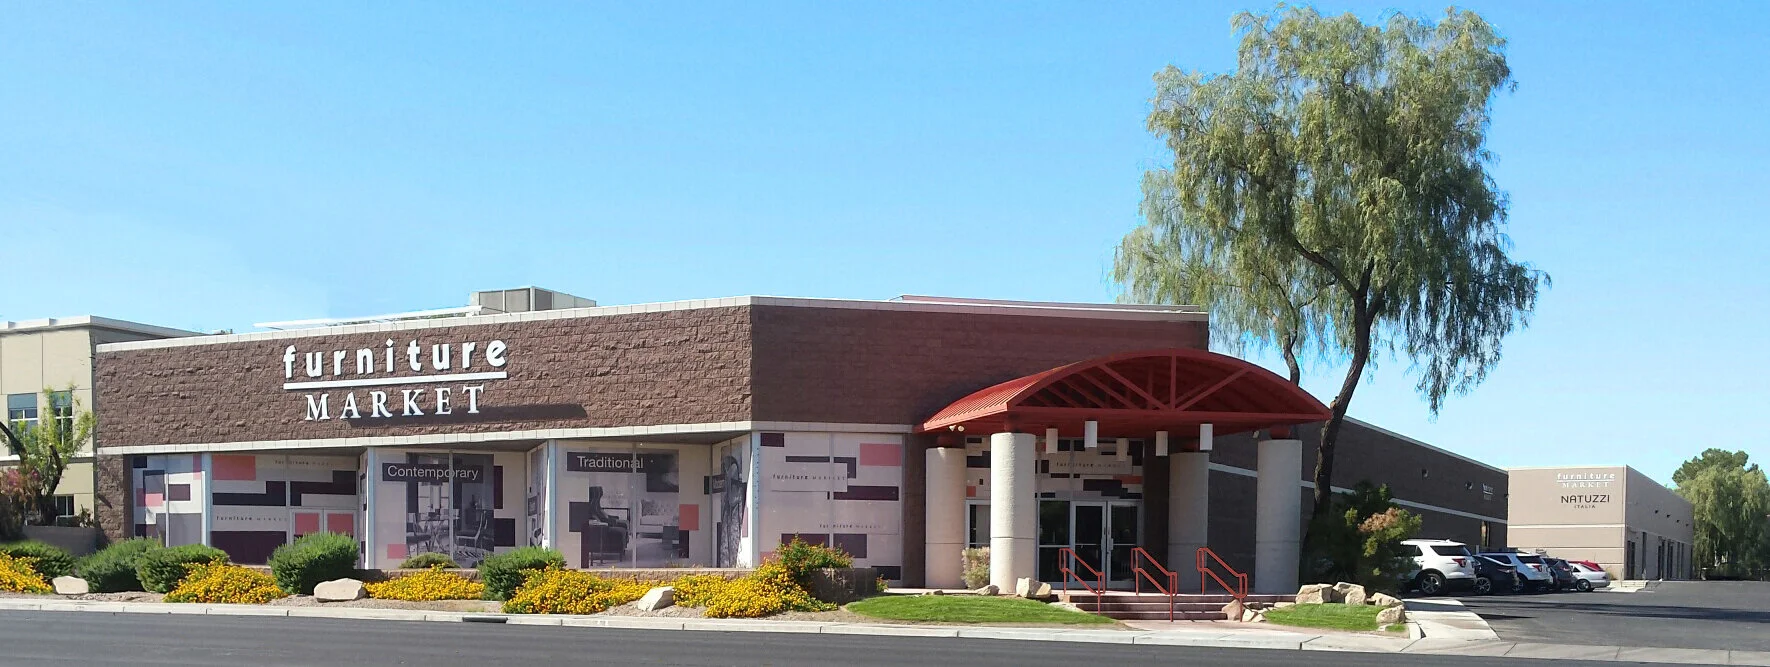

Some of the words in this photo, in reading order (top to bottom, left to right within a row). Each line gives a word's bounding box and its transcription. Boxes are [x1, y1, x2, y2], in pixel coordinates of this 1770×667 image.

[283, 338, 508, 379] furniture
[304, 384, 485, 421] MARKET
[576, 455, 644, 469] Traditional
[387, 465, 479, 481] Contemporary
[1557, 472, 1616, 480] furniture
[1561, 494, 1610, 503] NATUZZI
